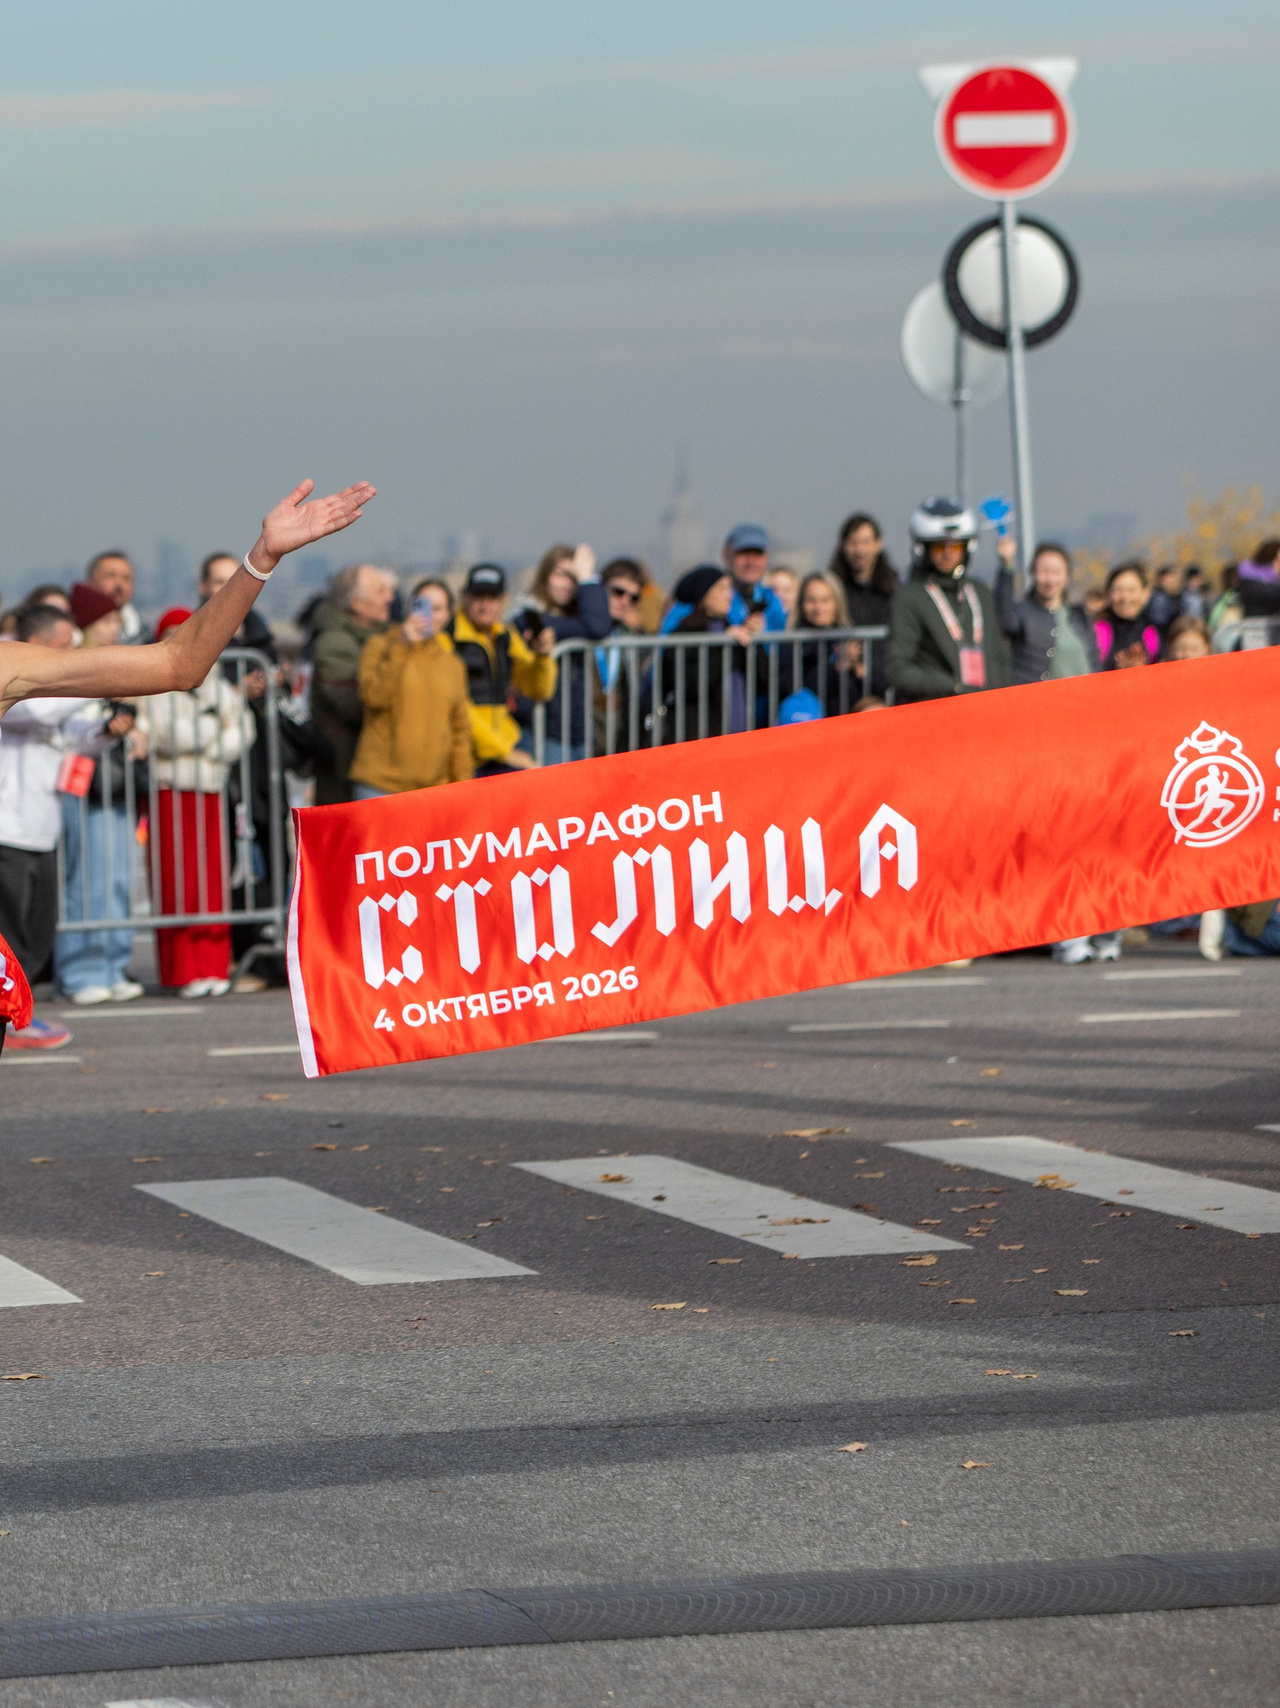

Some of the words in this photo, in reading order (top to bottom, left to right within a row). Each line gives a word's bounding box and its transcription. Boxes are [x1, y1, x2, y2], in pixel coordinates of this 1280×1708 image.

[354, 790, 724, 885] ПОЛУМАРАФОН
[357, 803, 919, 990] СТОЛИЦА
[373, 1008, 395, 1032] 4
[401, 980, 556, 1027] ОКТЯБРЯ
[561, 965, 639, 1002] 2026
